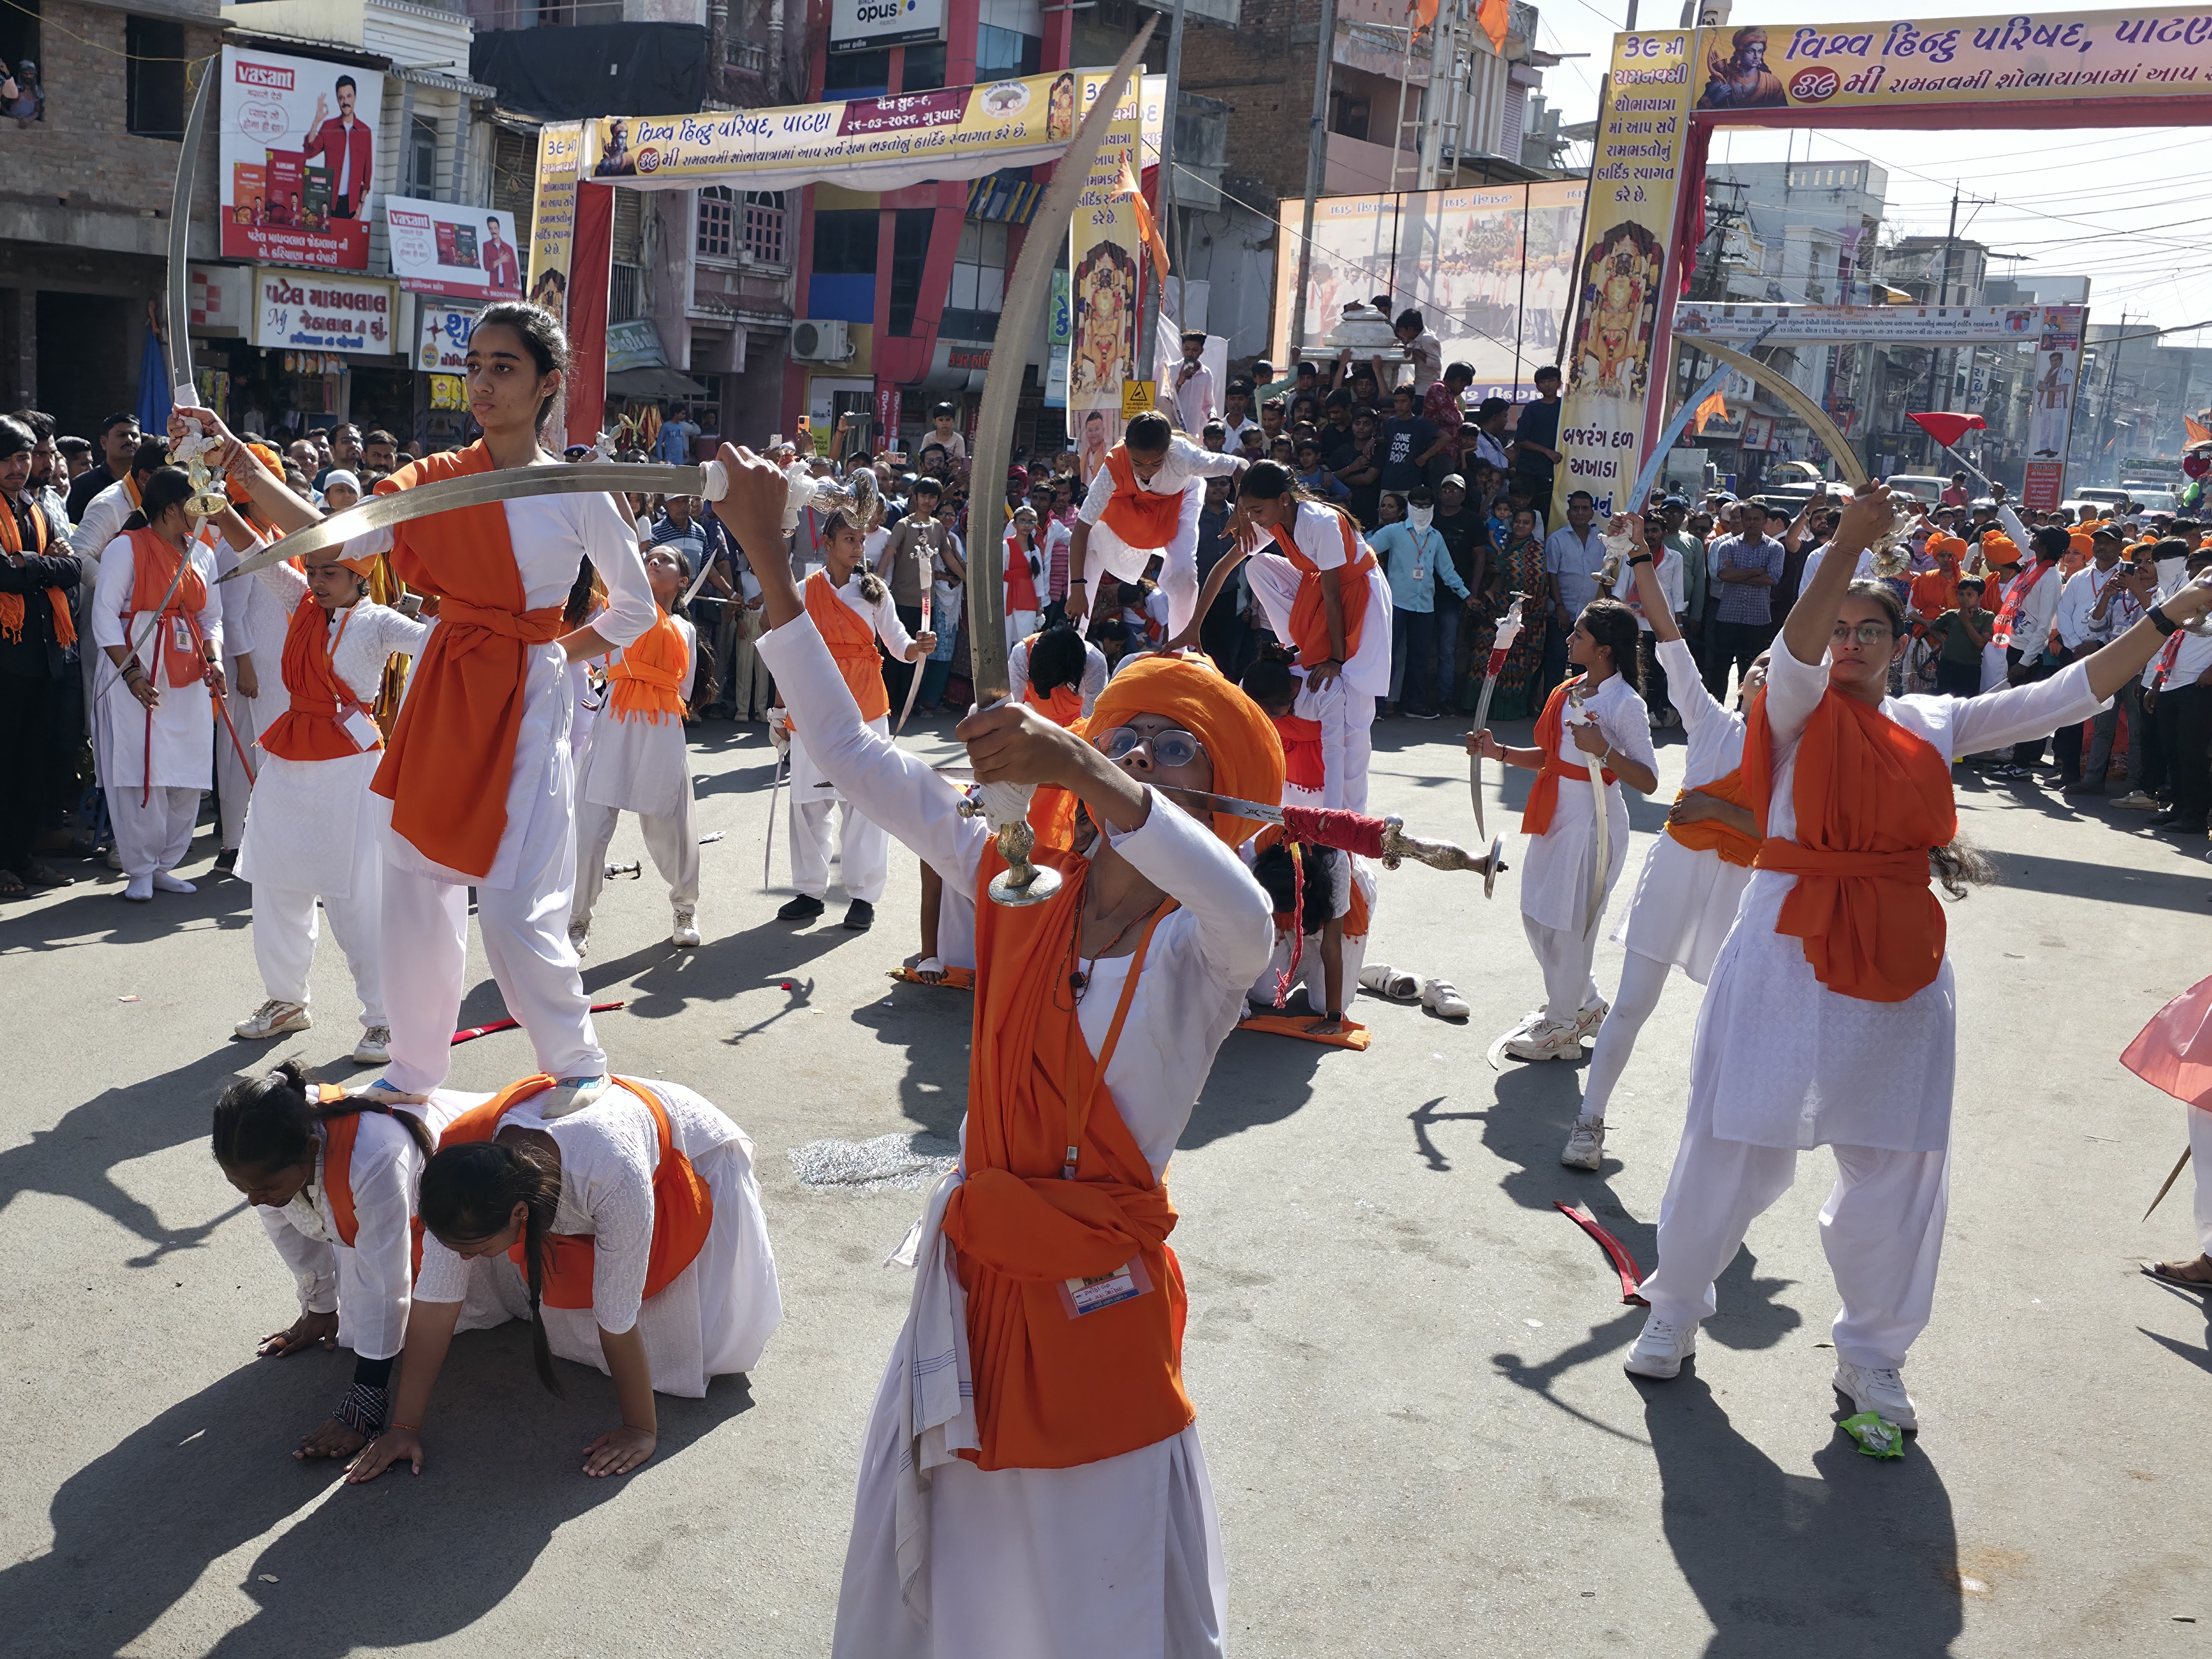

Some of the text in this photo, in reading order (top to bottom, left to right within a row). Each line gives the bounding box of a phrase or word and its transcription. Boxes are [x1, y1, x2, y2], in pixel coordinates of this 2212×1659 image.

[857, 3, 897, 23] opus
[1625, 37, 1685, 57] ૩૯ મી
[1786, 28, 1873, 60] વિશ્વ
[1882, 22, 1961, 63] હિન્દુ
[1972, 16, 2093, 52] પરિષદ,
[1614, 63, 1688, 85] રામનવમી
[1843, 66, 1886, 93] મી
[1889, 70, 1993, 94] રામનવમી
[1995, 63, 2142, 89] શોભાયાત્રામાં
[2146, 66, 2198, 81] આપ
[1615, 94, 1676, 111] શોભાયાત્રા
[636, 112, 831, 145] વિશ્વ હિન્દુ પરિષદ, પાટણ
[1609, 117, 1677, 133] માં આપ સર્વે
[548, 140, 565, 155] ૩૯
[662, 147, 680, 166] મી
[683, 150, 729, 166] રામનવમી
[730, 145, 796, 164] શોભાયાત્રામાં
[798, 148, 821, 159] આપ
[846, 143, 866, 155] રામ
[914, 131, 946, 149] હાર્દિક
[950, 130, 992, 145] સ્વાગત
[995, 124, 1010, 140] કરે
[1013, 122, 1027, 137] છે.
[1597, 162, 1674, 180] હાર્દિક સ્વાગત
[1615, 185, 1647, 202] કરે છે.
[1092, 210, 1105, 225] કરે
[265, 277, 387, 313] પટેલ માધવલાલ
[299, 309, 352, 333] જેઠાલાલ
[1563, 422, 1634, 449] બજરંગ દળ
[1571, 458, 1618, 478] અખાડા
